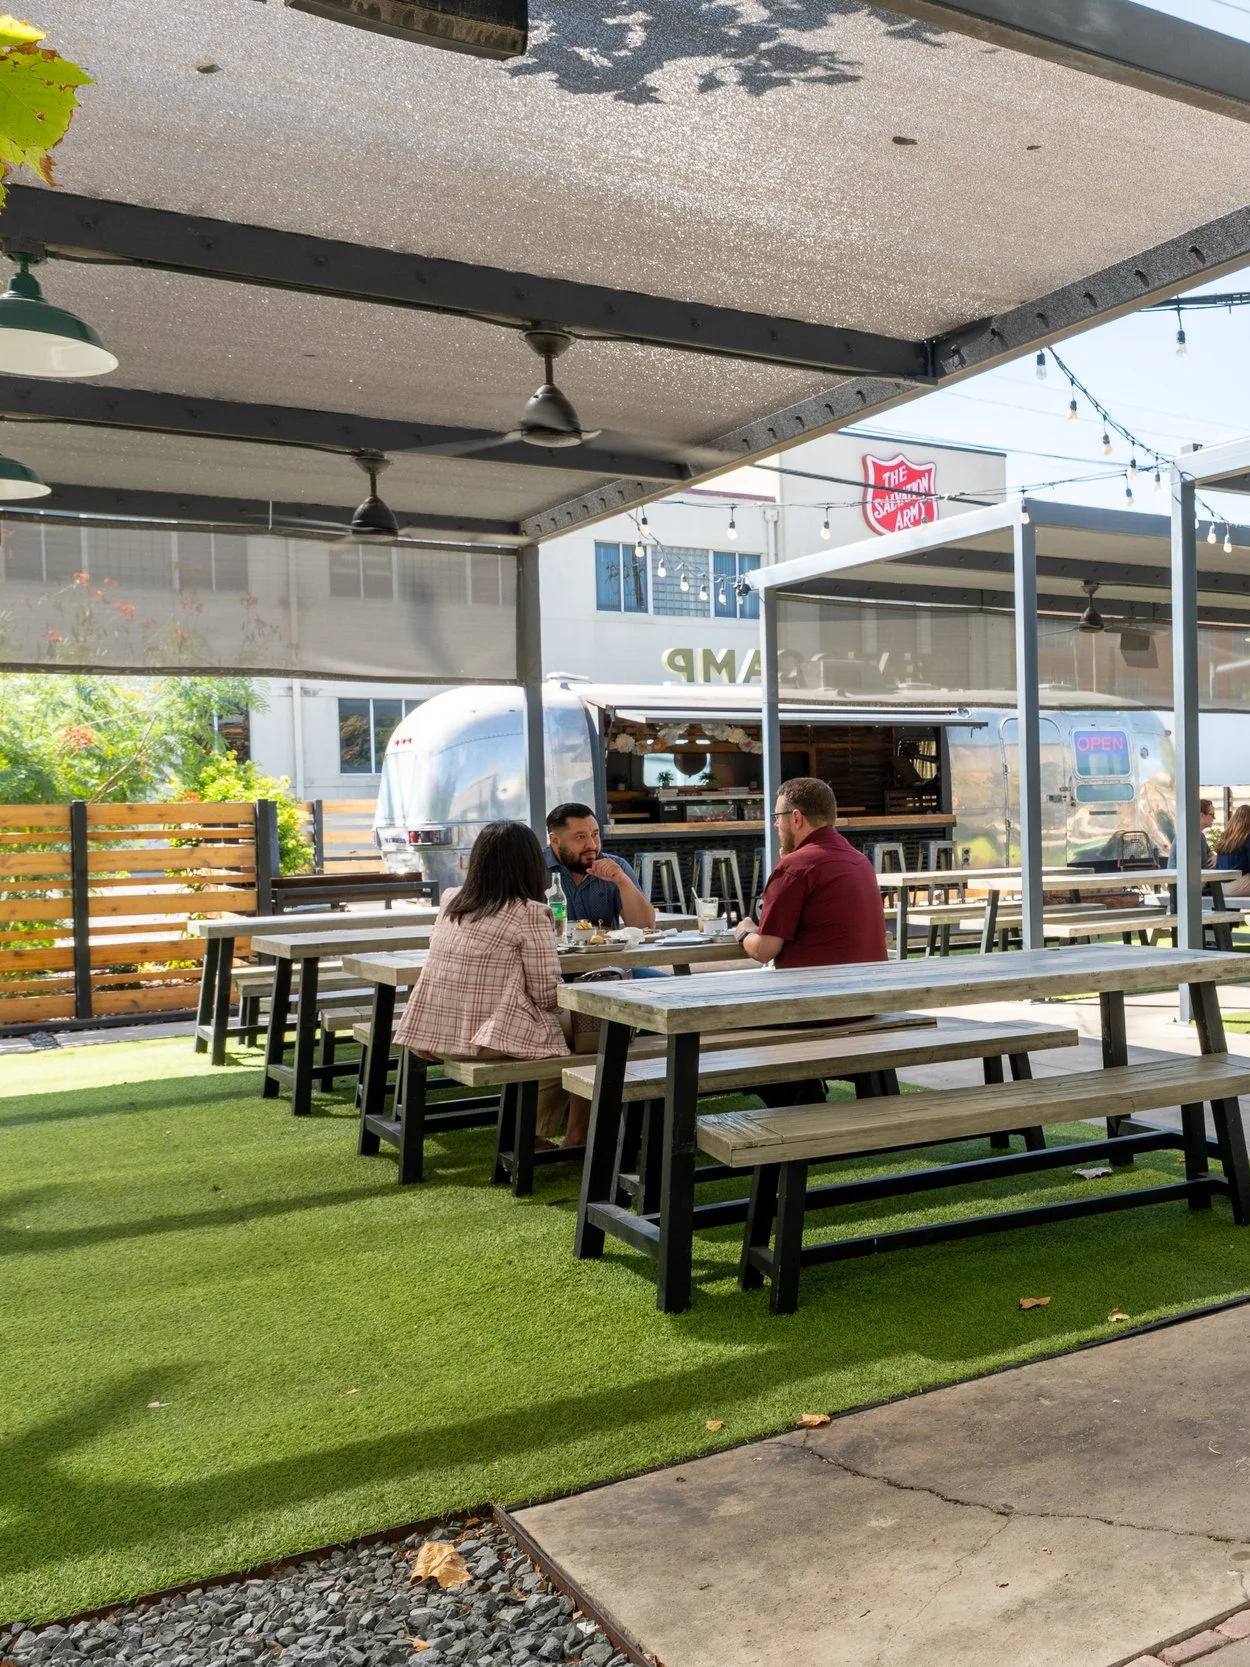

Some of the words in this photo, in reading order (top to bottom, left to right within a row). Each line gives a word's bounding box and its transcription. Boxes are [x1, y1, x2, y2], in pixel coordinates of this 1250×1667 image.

[882, 465, 907, 488] THE
[872, 472, 929, 519] SALVATION
[894, 498, 927, 532] ARMY
[1077, 735, 1123, 751] OPEN
